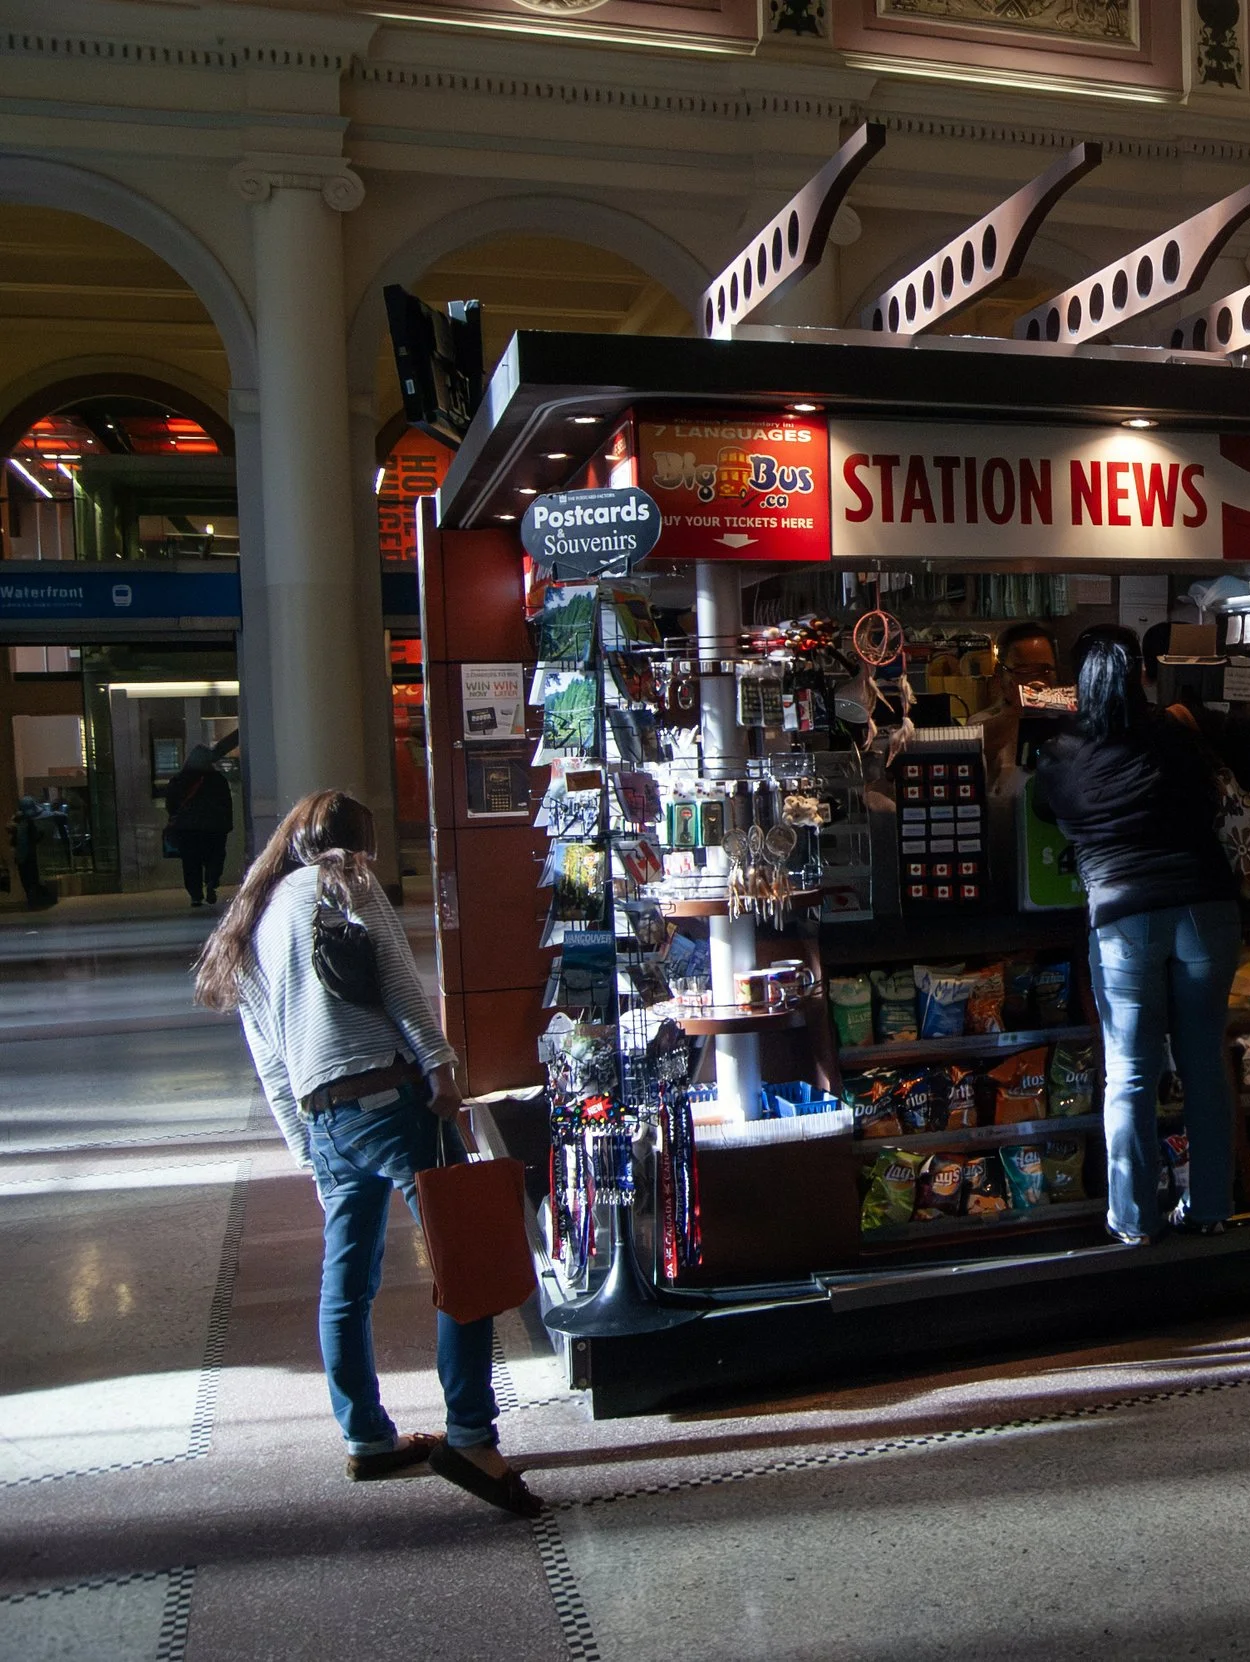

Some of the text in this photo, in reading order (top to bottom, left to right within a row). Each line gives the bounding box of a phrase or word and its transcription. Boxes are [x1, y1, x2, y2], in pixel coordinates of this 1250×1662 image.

[652, 425, 812, 443] 7 LANGUAGES
[652, 451, 814, 502] Big Bus
[842, 453, 1208, 529] STATION NEWS
[759, 494, 788, 508] .ca
[533, 496, 650, 529] Postcards
[661, 516, 814, 529] UY YOUR TICKETS HERE
[557, 528, 565, 539] &
[544, 530, 637, 556] Souvenirs
[0, 584, 84, 599] Waterfront
[466, 680, 518, 691] WIN WIN
[563, 933, 613, 947] VANCOUVER
[587, 1101, 604, 1116] NEW
[555, 1150, 563, 1197] CANADA
[664, 1197, 673, 1245] CANADA
